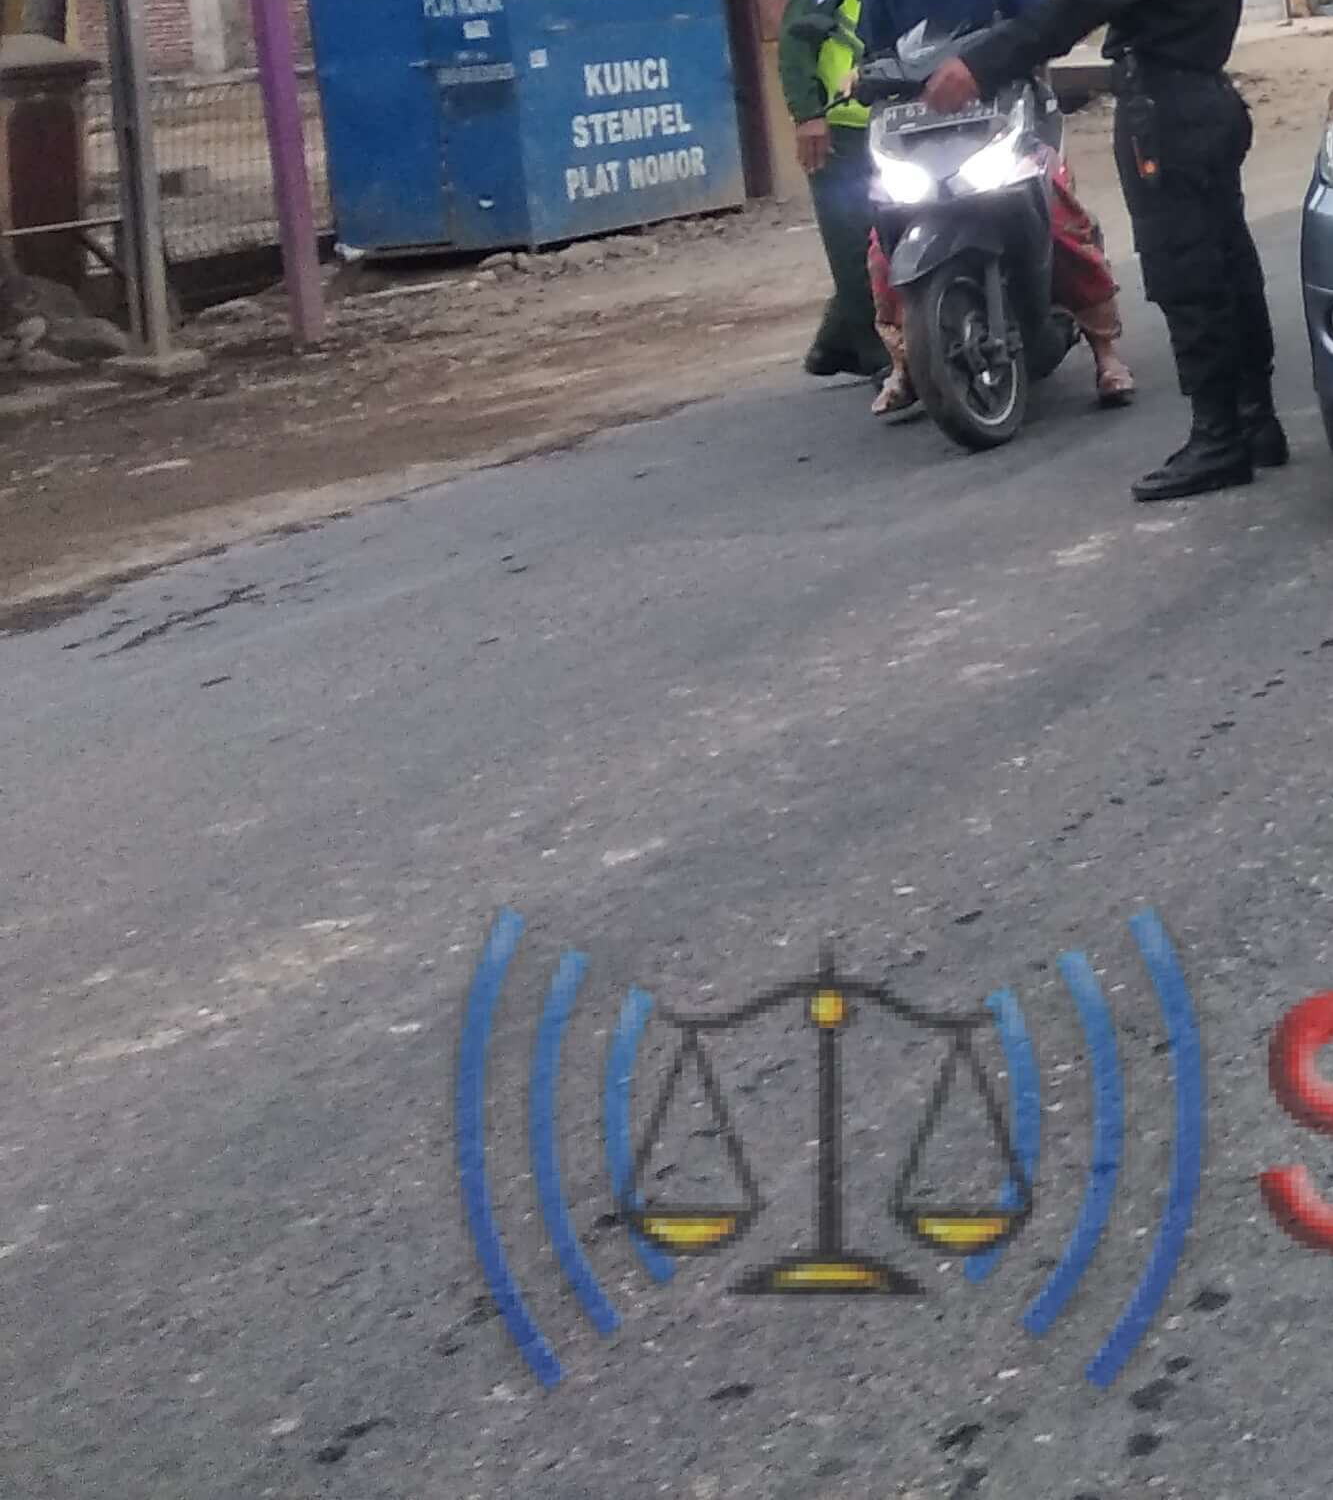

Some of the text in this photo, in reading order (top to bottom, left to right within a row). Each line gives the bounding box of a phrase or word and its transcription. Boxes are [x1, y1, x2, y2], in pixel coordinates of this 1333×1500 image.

[583, 57, 669, 97] KUNCI
[572, 103, 692, 148] STEMPEL
[565, 146, 706, 201] PLAT NOMOR
